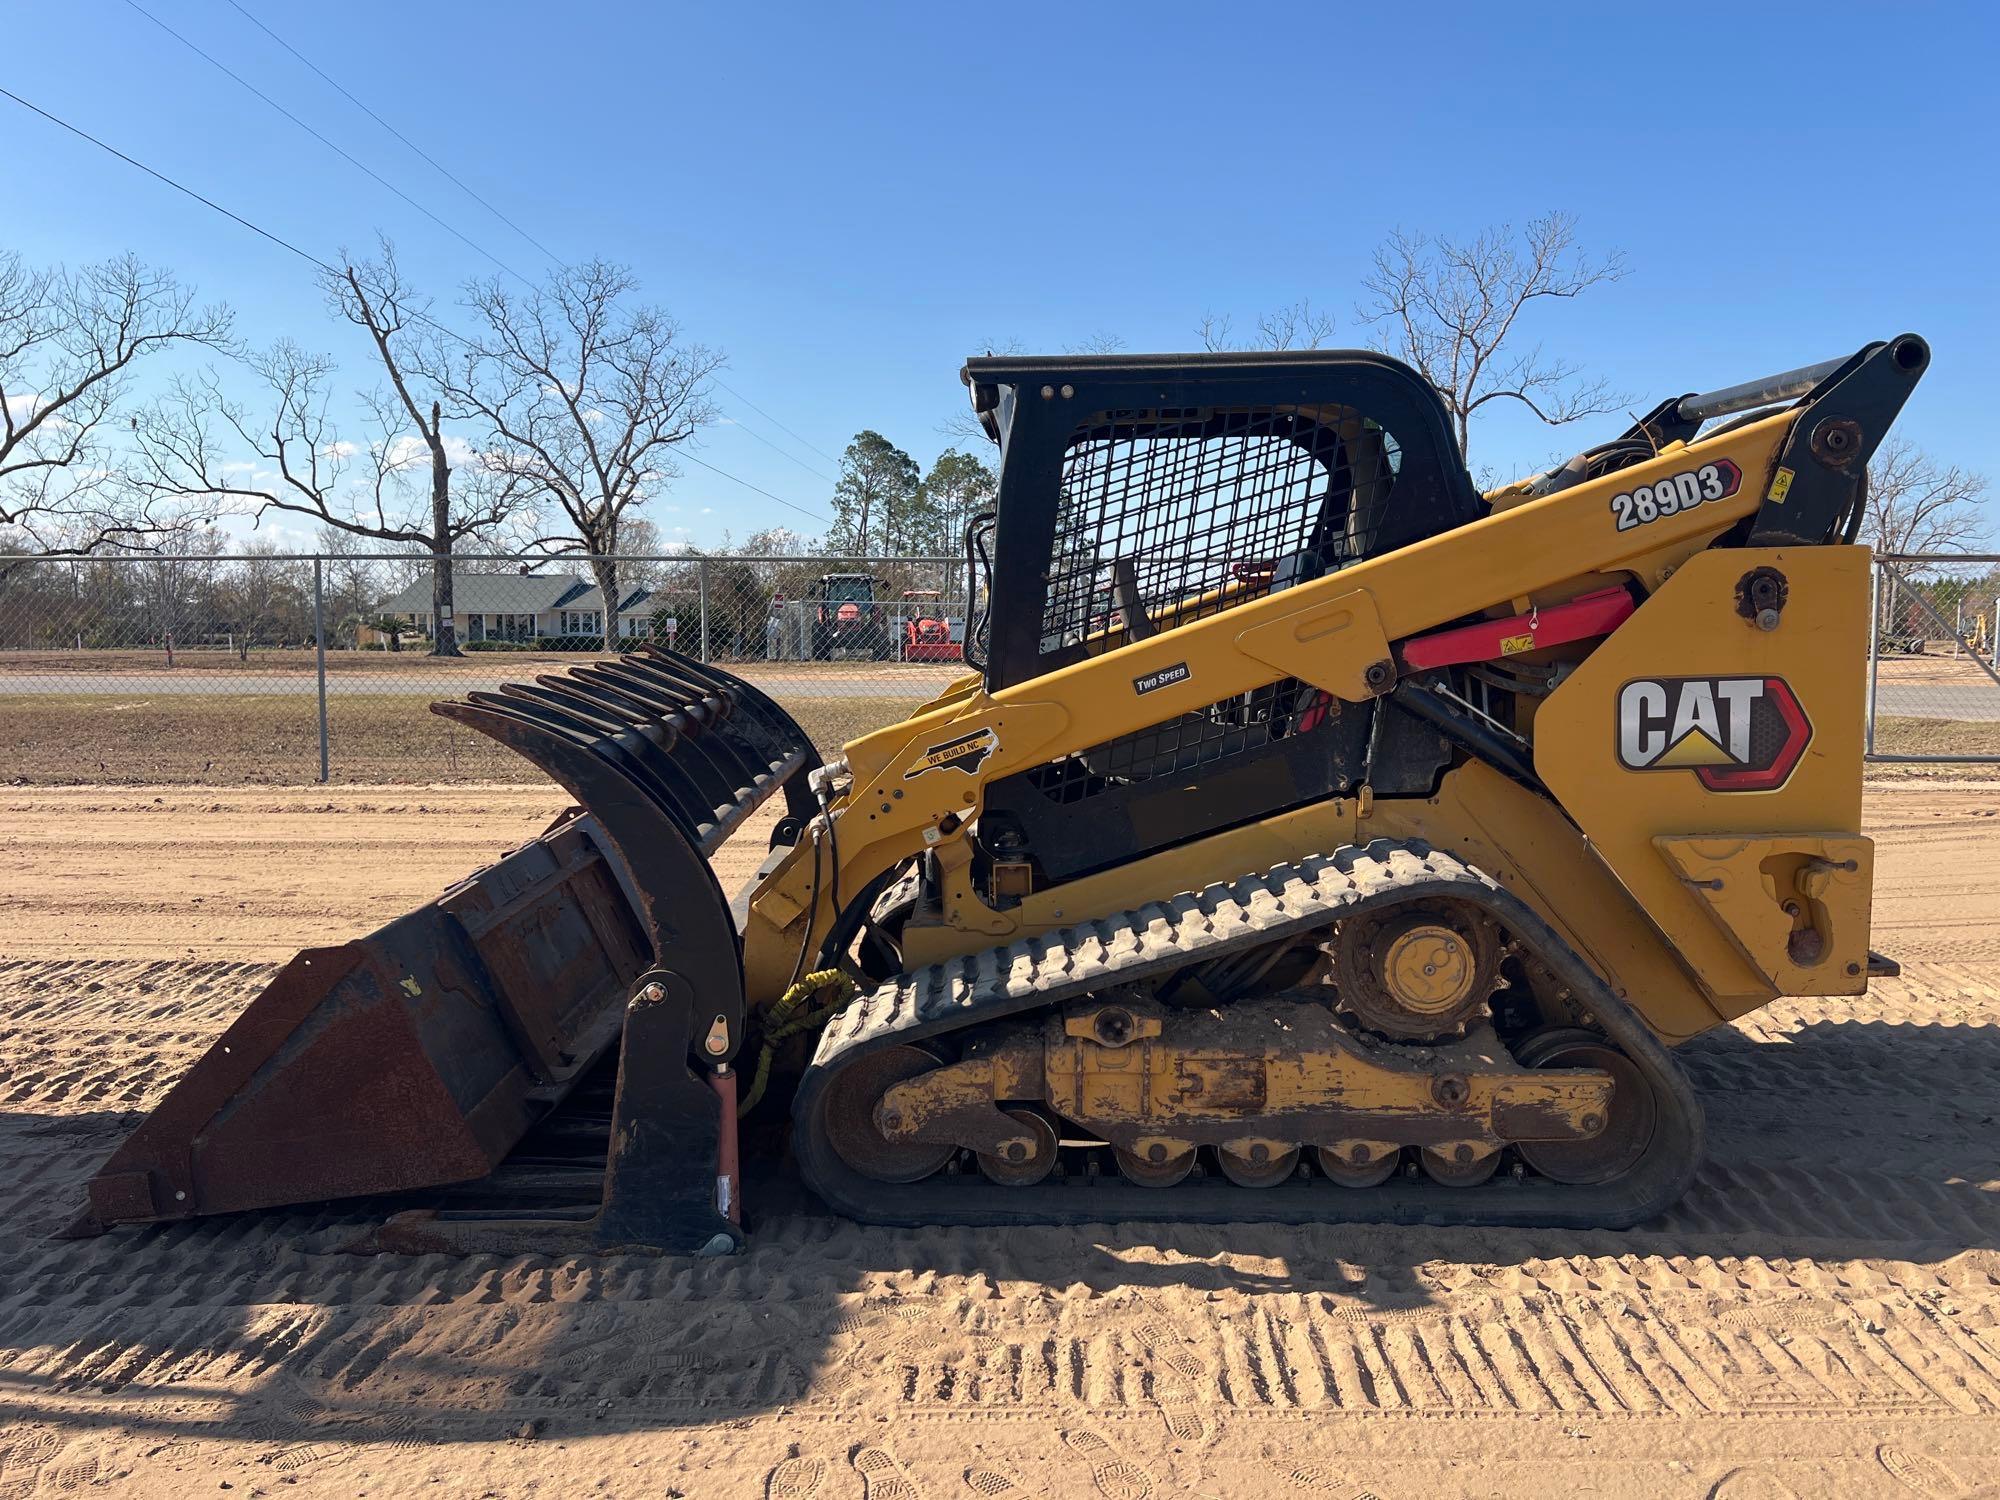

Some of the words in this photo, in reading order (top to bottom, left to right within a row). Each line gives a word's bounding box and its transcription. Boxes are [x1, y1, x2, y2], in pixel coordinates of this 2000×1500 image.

[1612, 465, 1724, 532] 289D3
[927, 755, 942, 765] WE
[943, 746, 966, 759] BUILD
[967, 741, 980, 750] NC
[1621, 680, 1763, 766] CAT
